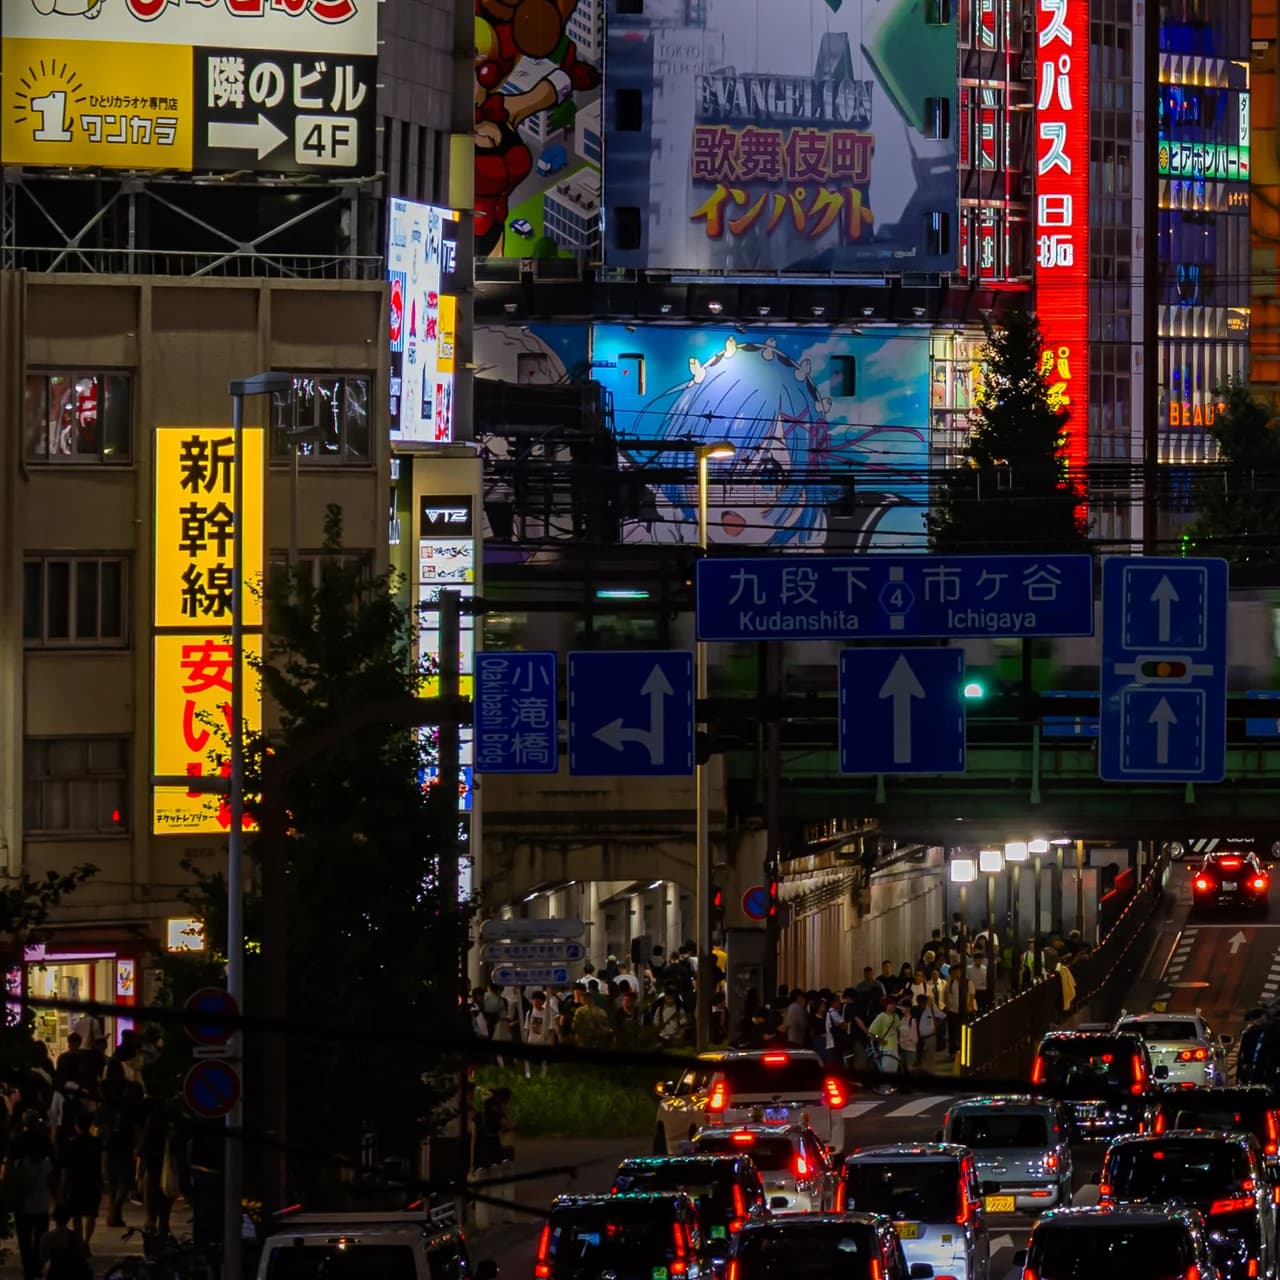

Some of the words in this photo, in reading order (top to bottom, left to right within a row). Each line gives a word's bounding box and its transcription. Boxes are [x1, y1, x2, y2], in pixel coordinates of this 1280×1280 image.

[207, 55, 367, 113] 隣のビル
[80, 113, 178, 146] ワンカラ
[302, 124, 351, 158] 4F
[691, 124, 878, 184] 歌舞伎町
[689, 182, 877, 240] インパクト
[728, 566, 869, 606] 九段下
[890, 588, 903, 608] 4
[740, 609, 860, 632] Kudanshita
[948, 608, 1038, 632] Ichigaya
[481, 658, 509, 729] Otakibashi
[511, 661, 550, 765] 小滝橋
